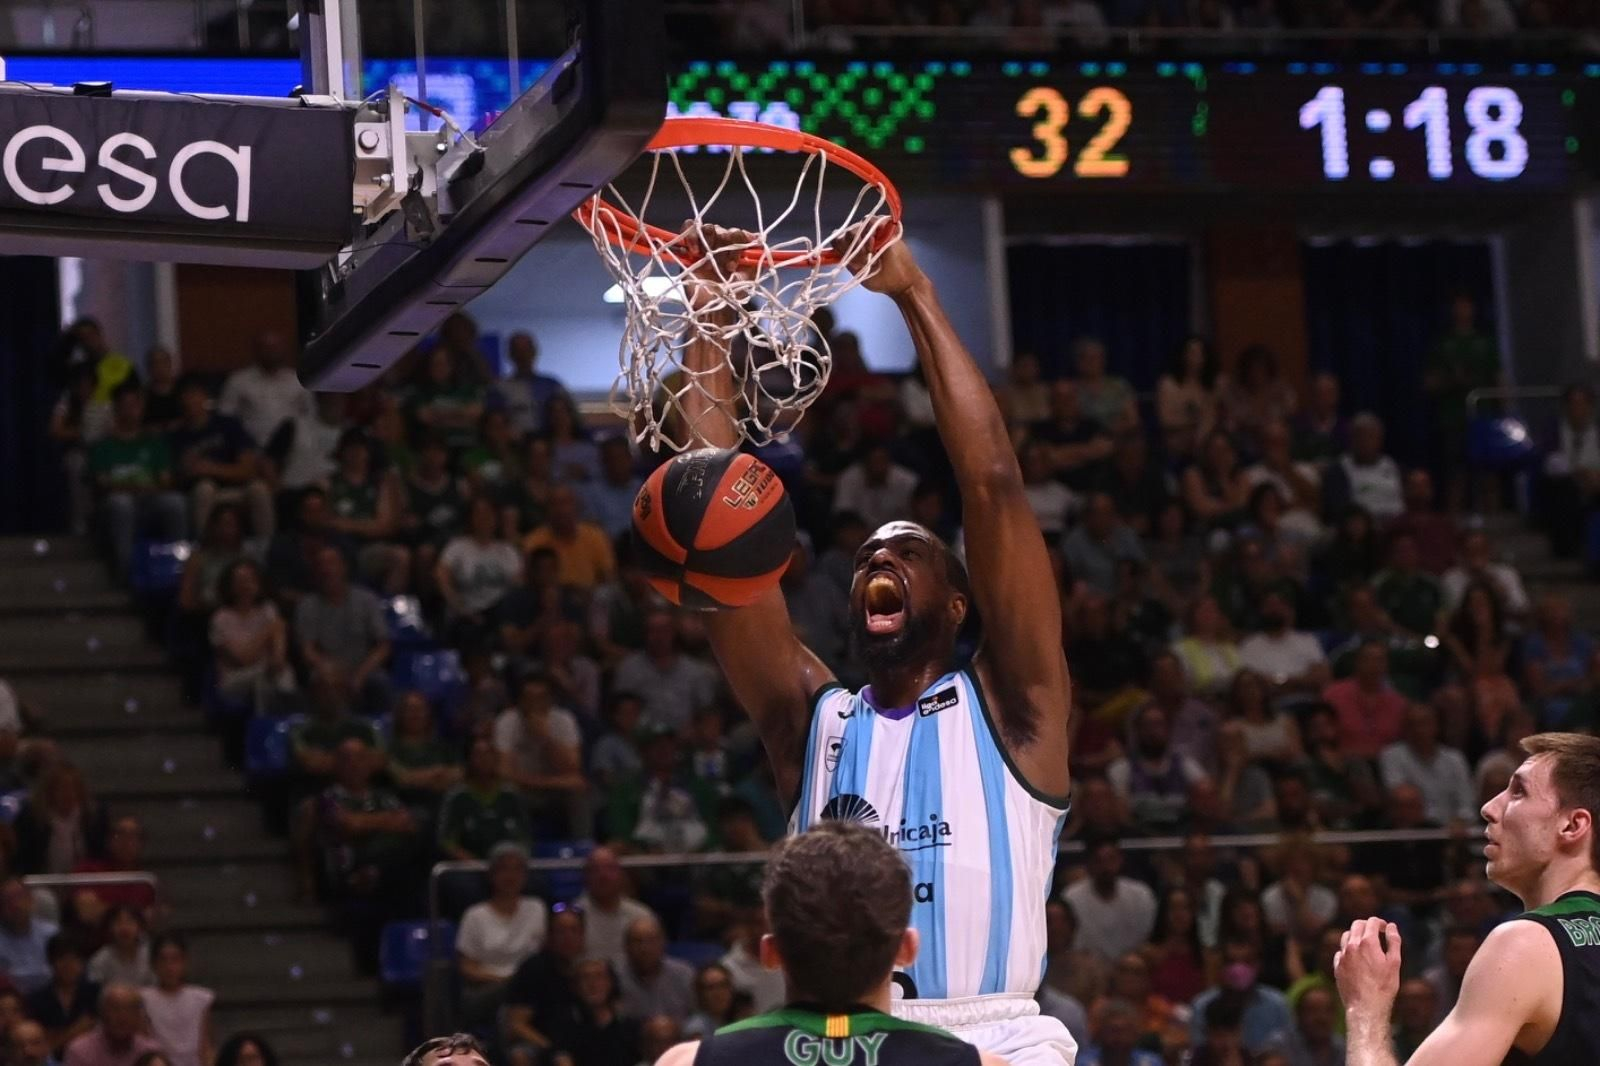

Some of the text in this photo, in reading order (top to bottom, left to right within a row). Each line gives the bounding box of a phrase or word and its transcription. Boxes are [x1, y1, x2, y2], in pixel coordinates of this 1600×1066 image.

[3, 125, 252, 222] esa
[1009, 86, 1132, 178] 32
[1299, 85, 1528, 179] 1:18
[784, 1029, 889, 1066] GUY
